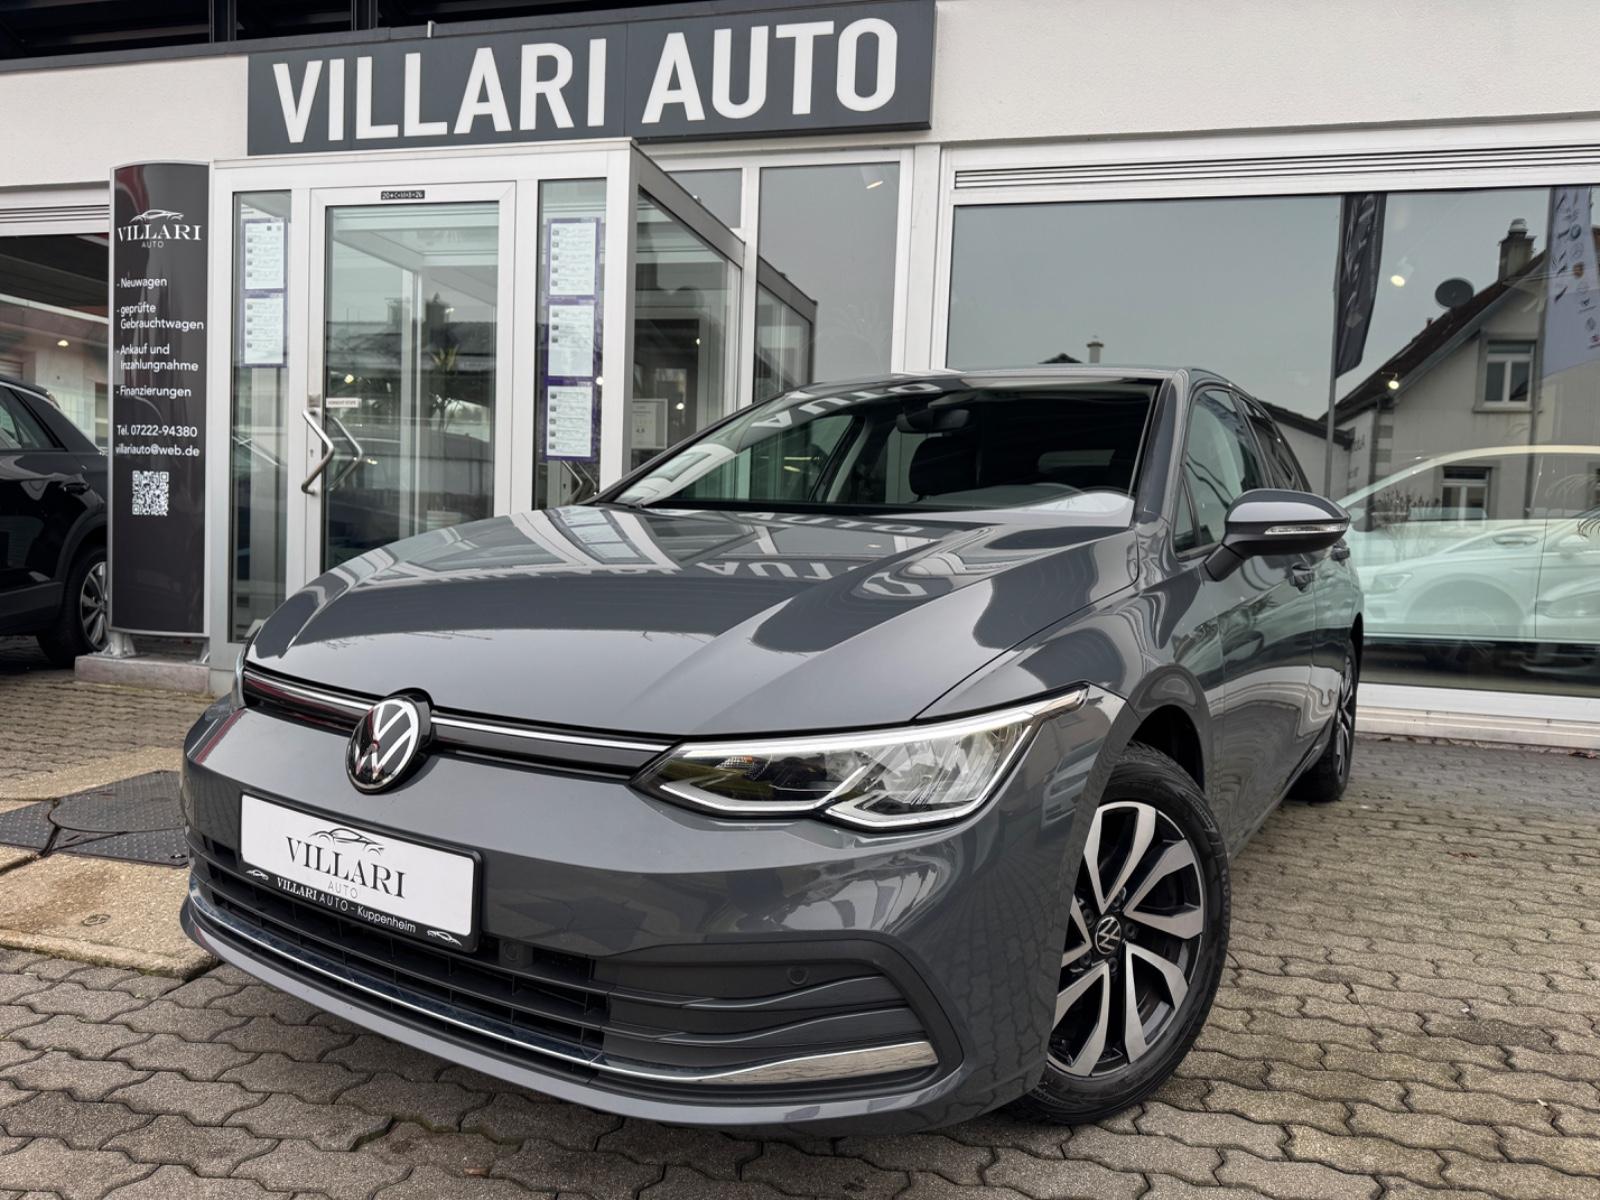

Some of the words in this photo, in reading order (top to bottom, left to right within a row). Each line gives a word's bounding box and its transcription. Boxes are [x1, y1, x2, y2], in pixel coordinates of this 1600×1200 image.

[273, 39, 606, 143] VILLARI
[641, 18, 898, 124] AUTO
[118, 223, 202, 242] VILLARI
[141, 240, 165, 249] AUTO
[120, 277, 168, 290] Neuwagen
[120, 301, 157, 317] geprüfte
[120, 317, 205, 333] Gebrauchtwagen
[120, 343, 148, 356] Ankauf
[150, 344, 170, 355] und
[120, 359, 199, 373] Inzahlungnahme
[120, 385, 192, 400] Finanzierungen
[117, 425, 130, 436] Tel.
[130, 424, 198, 438] 07222-94380
[115, 443, 201, 457] villariauto@web.de
[286, 835, 406, 899] VILLARI
[328, 880, 359, 900] AUTO
[277, 876, 318, 901] VILLARI
[318, 895, 349, 912] AUTO
[357, 905, 417, 934] Kuppenheim
